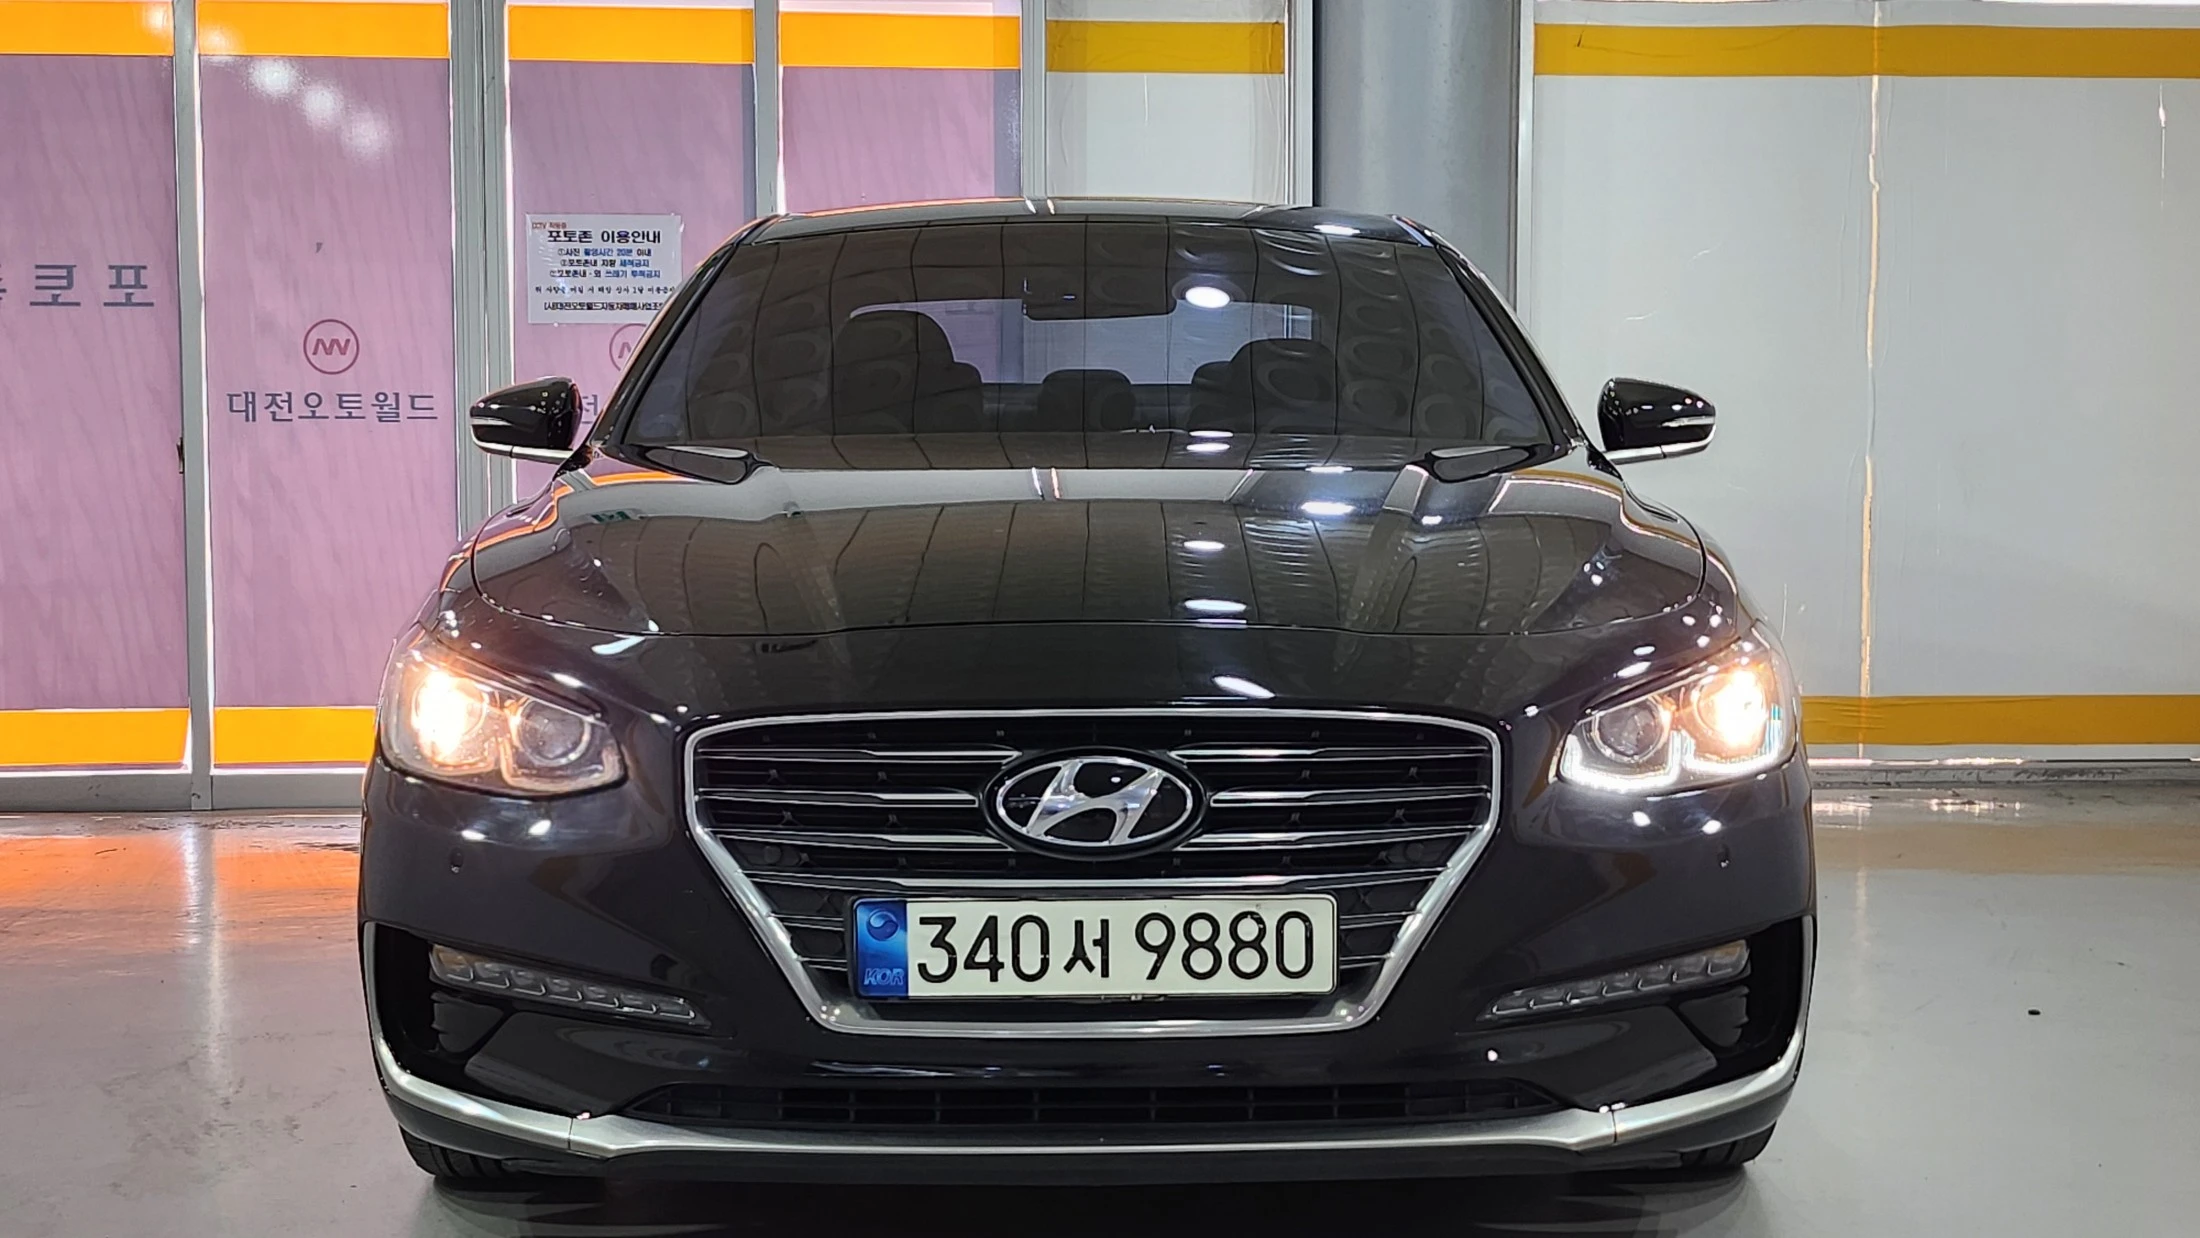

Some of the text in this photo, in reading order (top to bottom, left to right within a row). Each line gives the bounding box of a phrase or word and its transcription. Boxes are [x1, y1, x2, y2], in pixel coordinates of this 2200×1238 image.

[547, 230, 661, 244] 포토존 이용안내
[637, 248, 651, 256] 이내
[227, 392, 438, 422] 대전오토월드
[1135, 910, 1314, 980] 9880
[863, 967, 904, 986] KOR
